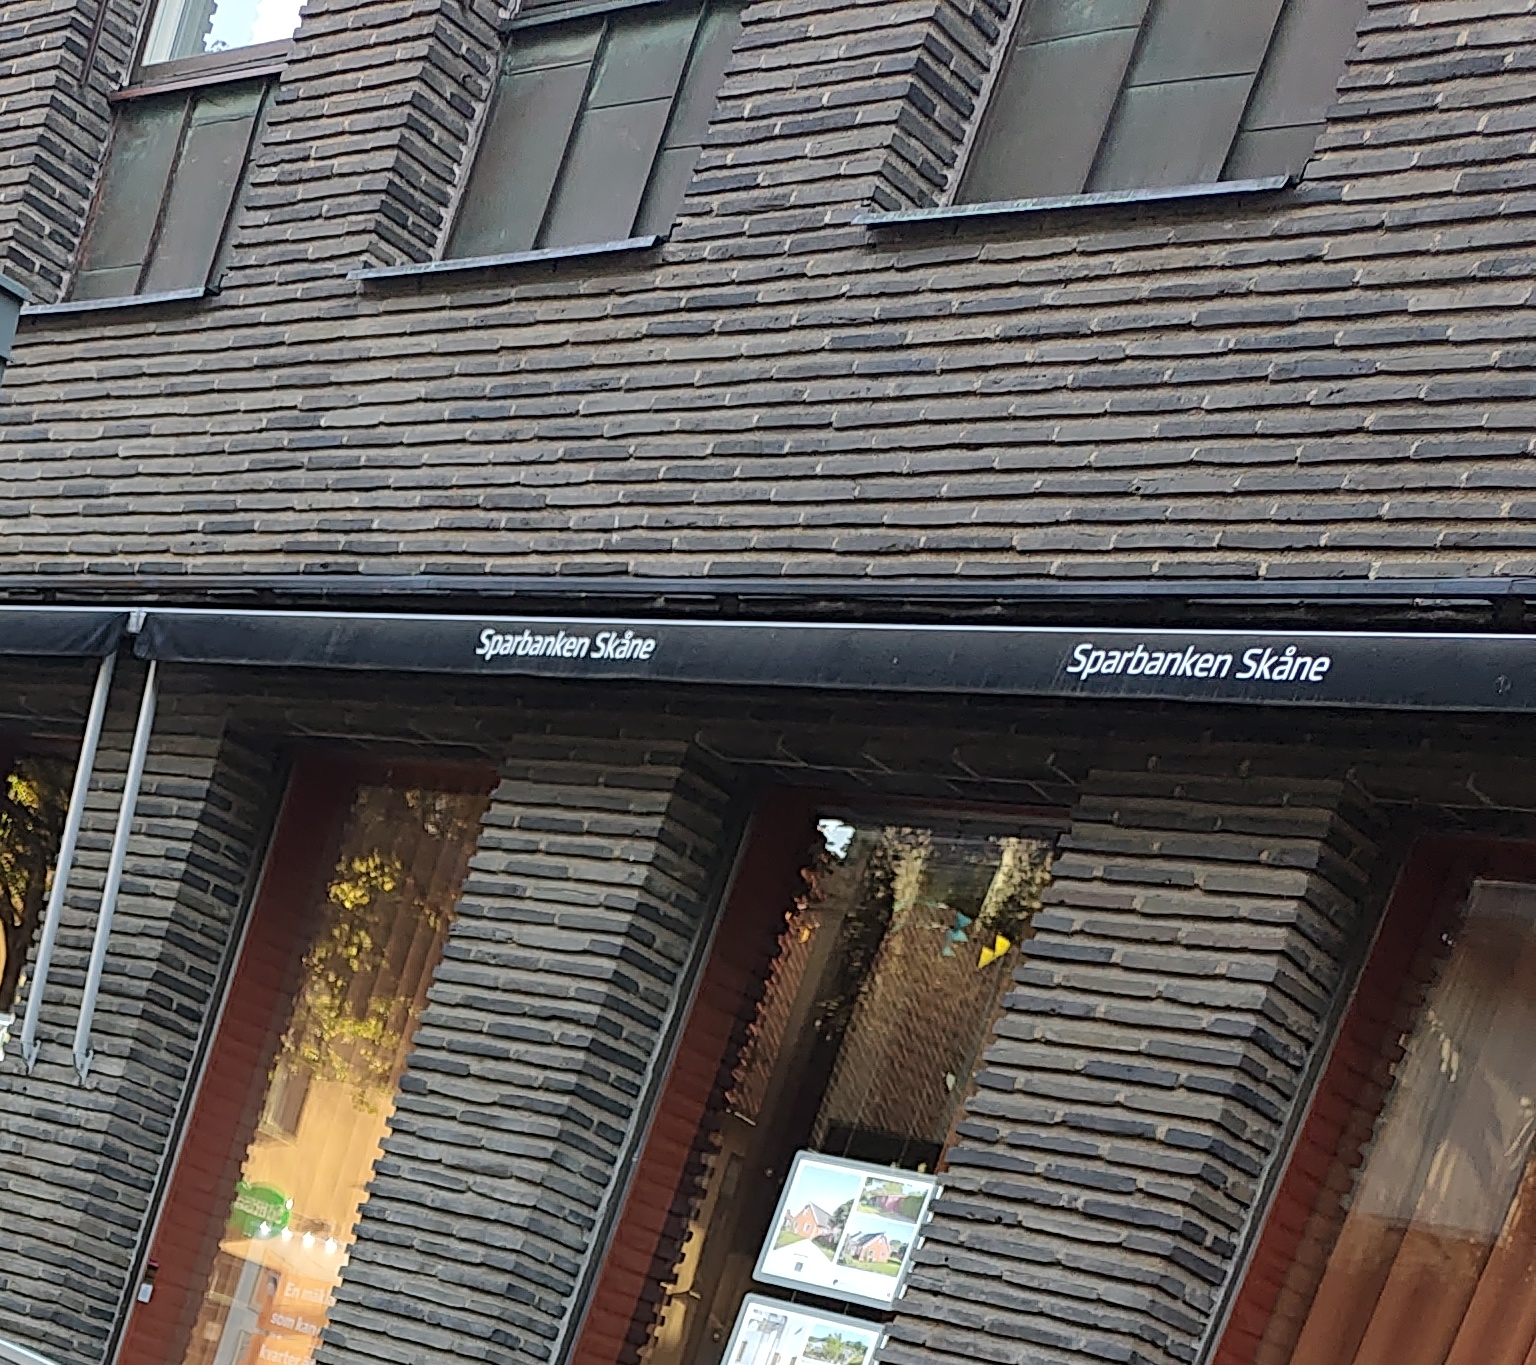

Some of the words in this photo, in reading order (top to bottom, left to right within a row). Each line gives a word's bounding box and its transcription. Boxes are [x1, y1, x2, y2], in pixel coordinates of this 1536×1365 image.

[476, 628, 591, 661] Sparbanken
[590, 630, 656, 660] Skåne
[1066, 643, 1233, 680] Sparbanken
[1235, 645, 1330, 681] Skåne
